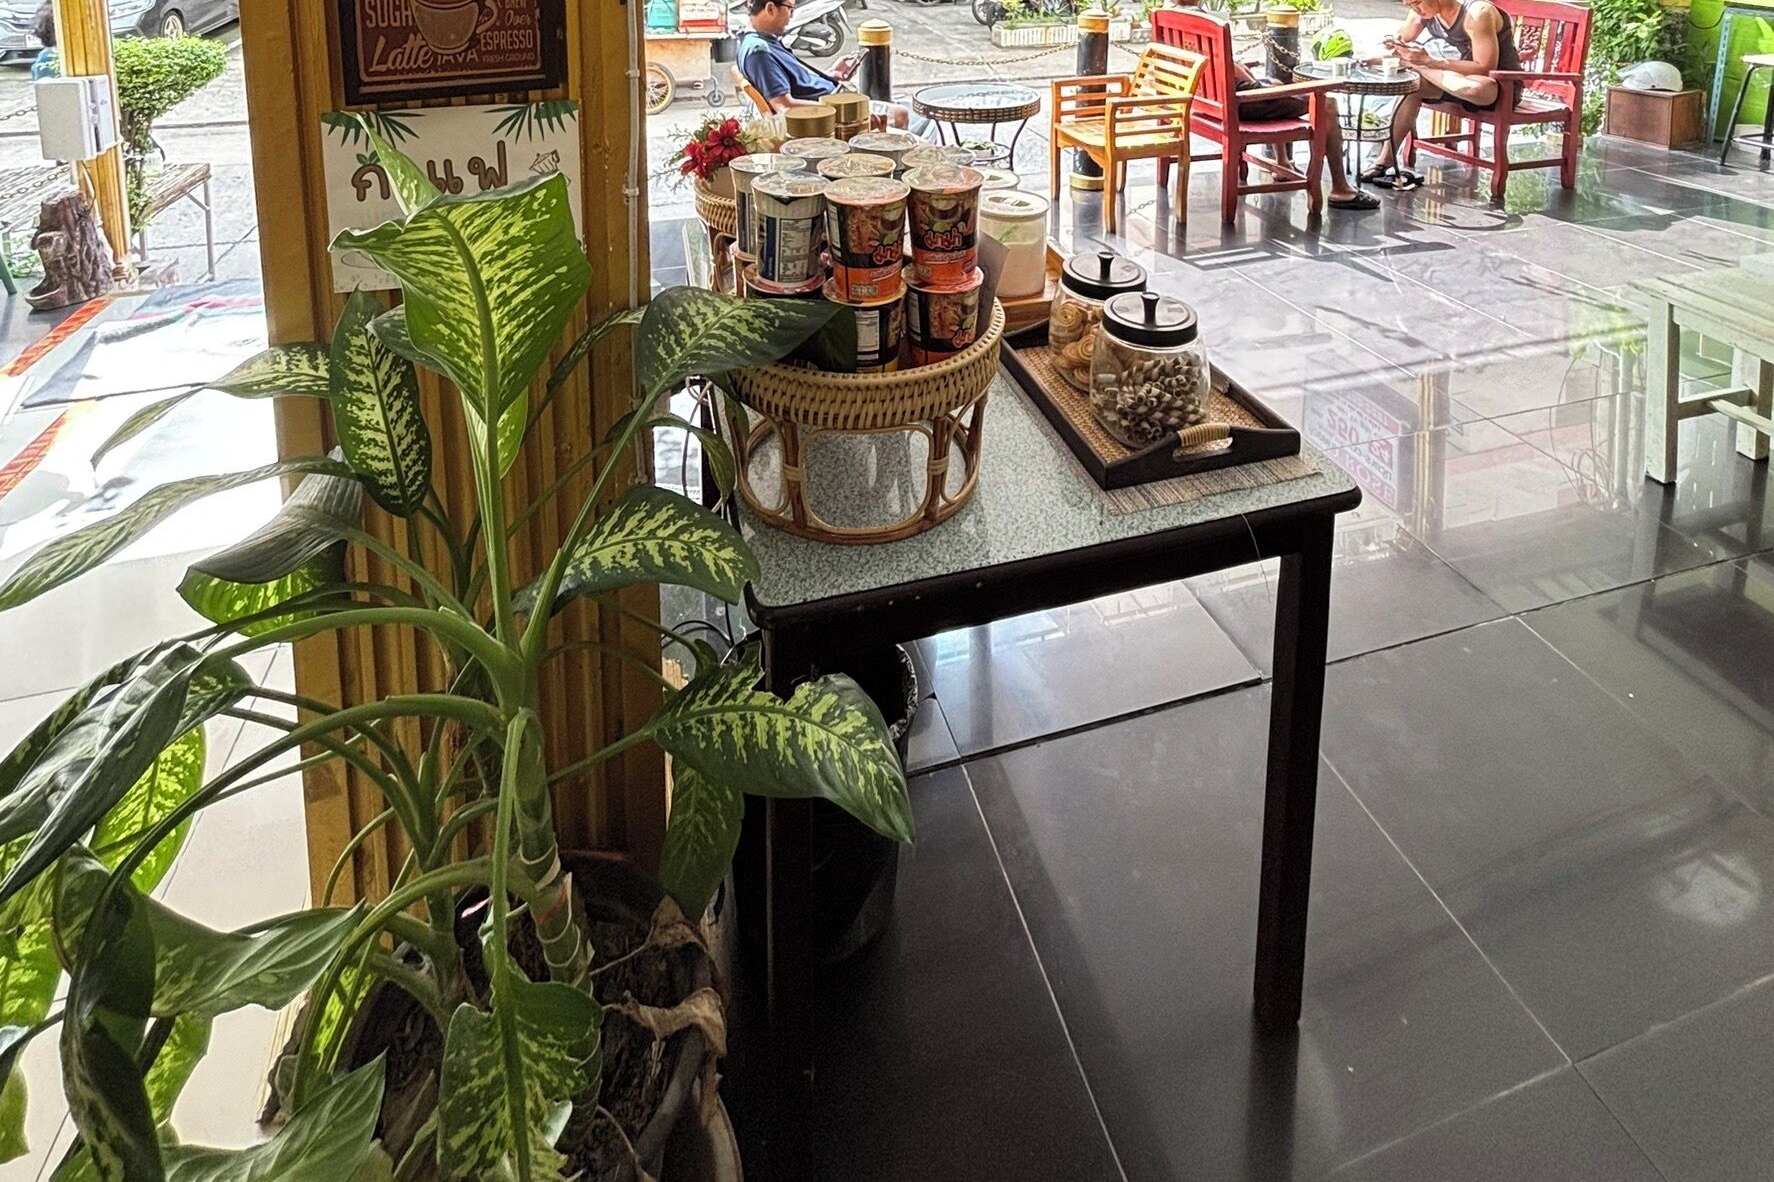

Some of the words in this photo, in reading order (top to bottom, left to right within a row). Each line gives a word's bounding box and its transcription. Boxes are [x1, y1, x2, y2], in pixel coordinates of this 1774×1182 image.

[480, 29, 534, 52] ESPRESSO
[368, 33, 434, 72] Latte
[482, 55, 504, 63] FRESH
[505, 52, 535, 62] GROUND
